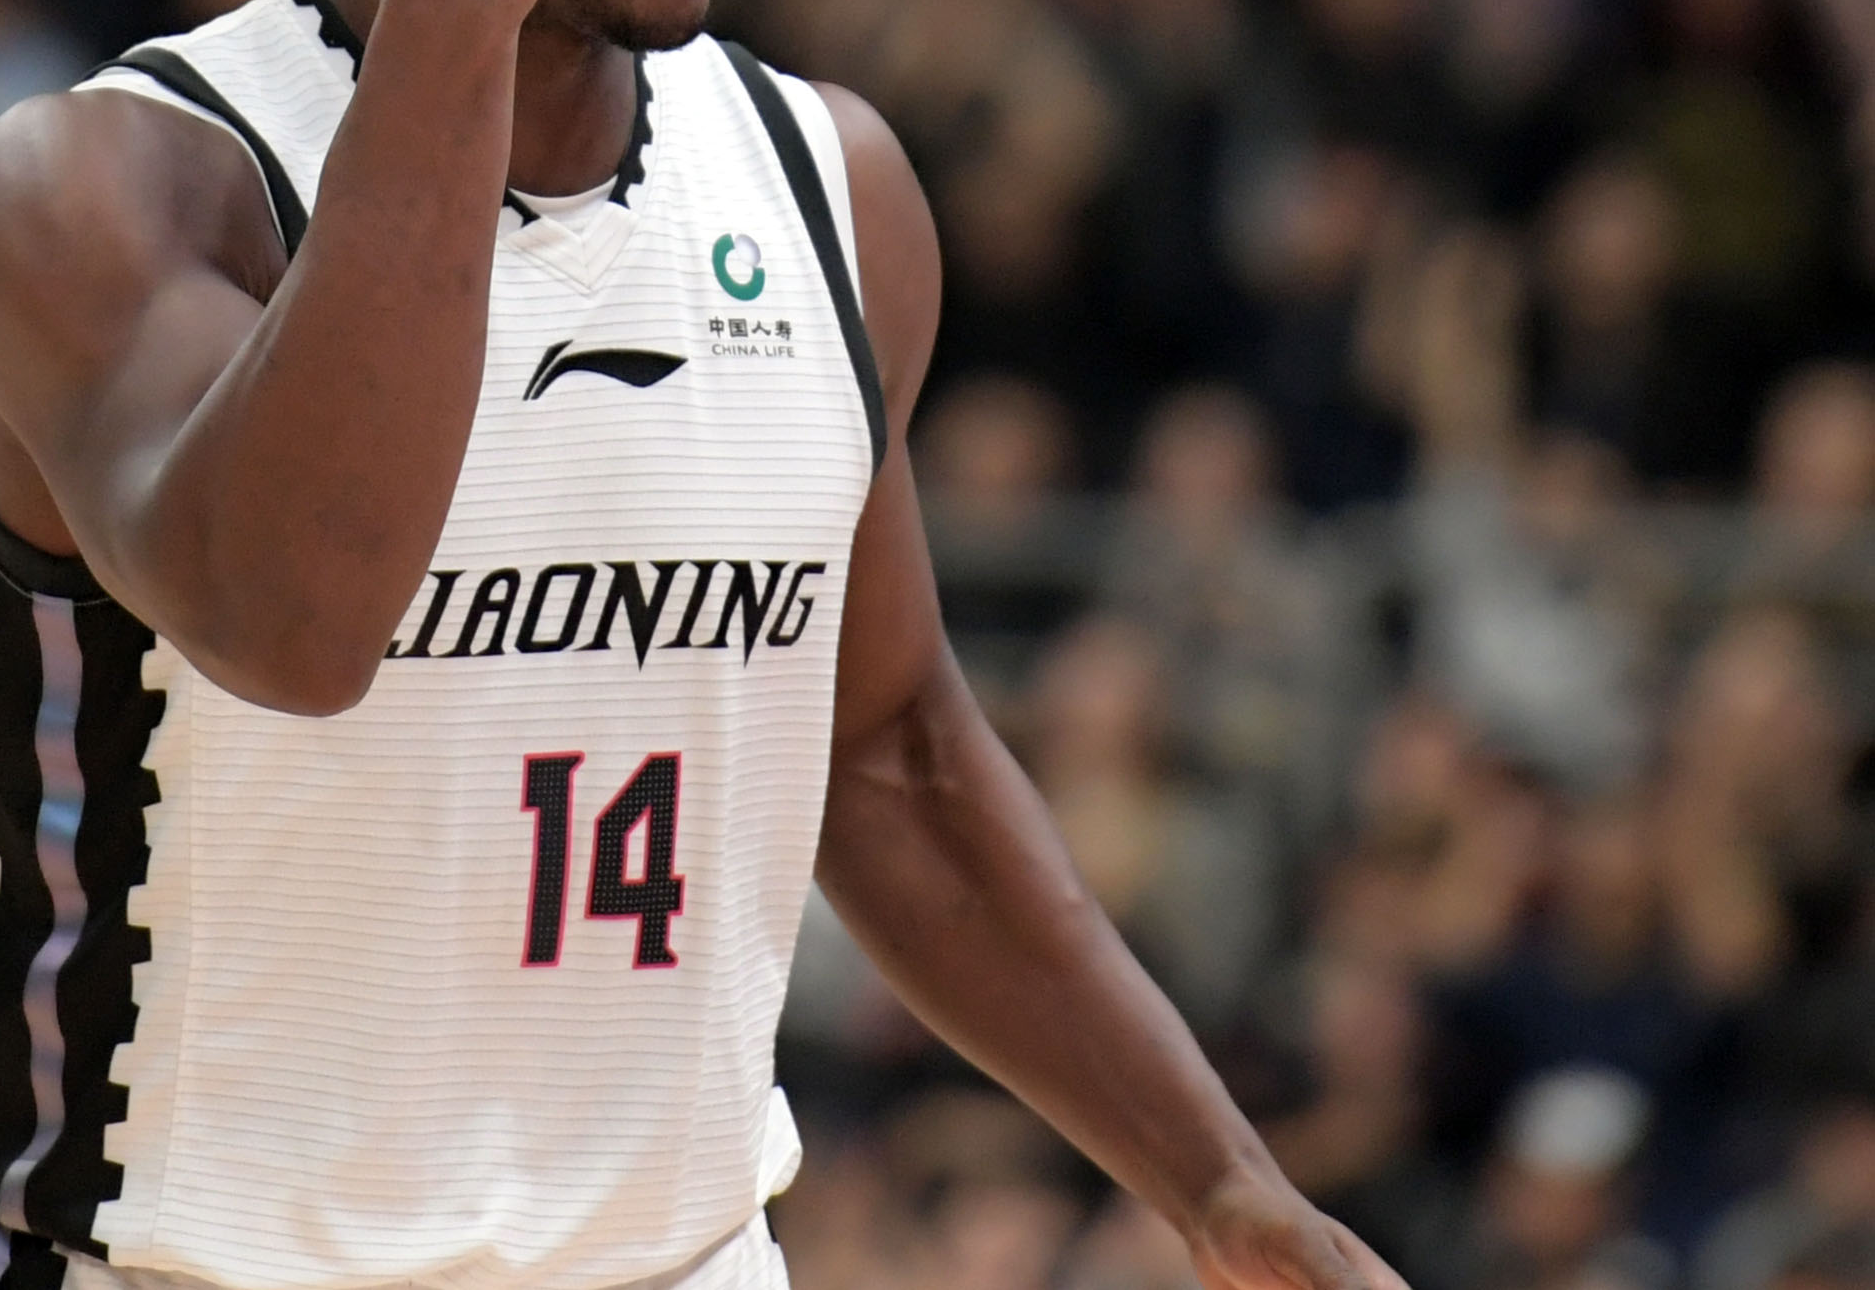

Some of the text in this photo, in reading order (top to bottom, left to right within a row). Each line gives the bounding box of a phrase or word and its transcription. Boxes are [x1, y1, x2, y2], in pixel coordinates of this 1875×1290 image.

[709, 316, 792, 341] 中国人寿
[711, 343, 795, 358] CHINA LIFE
[384, 560, 826, 670] IAONING
[520, 751, 685, 970] 14
